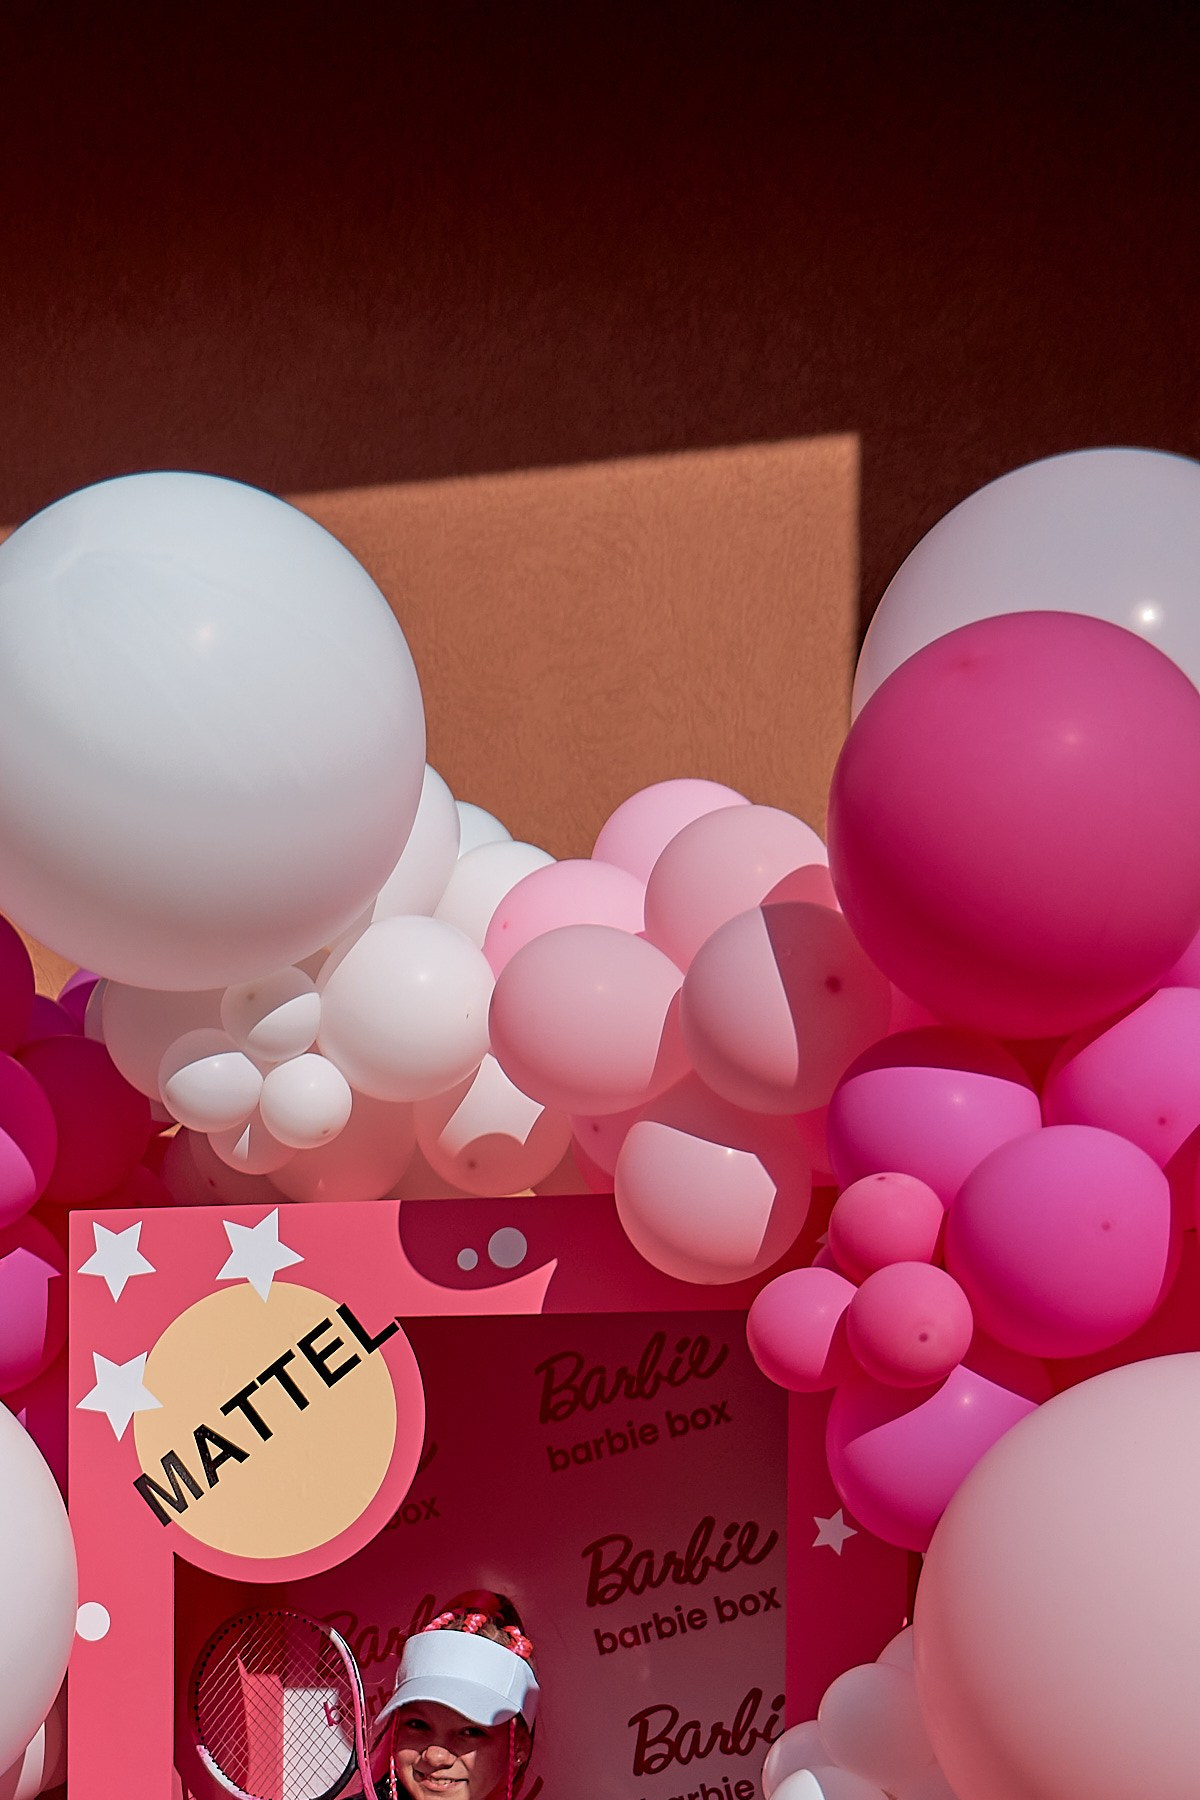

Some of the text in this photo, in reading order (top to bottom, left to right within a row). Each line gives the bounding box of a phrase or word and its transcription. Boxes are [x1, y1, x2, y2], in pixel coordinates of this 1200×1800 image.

[133, 1303, 400, 1526] MATTEL
[534, 1331, 730, 1424] Barbie
[546, 1400, 732, 1472] barbie box
[581, 1515, 779, 1608] Barbie
[594, 1587, 782, 1656] barbie box
[628, 1687, 785, 1776] Barbi
